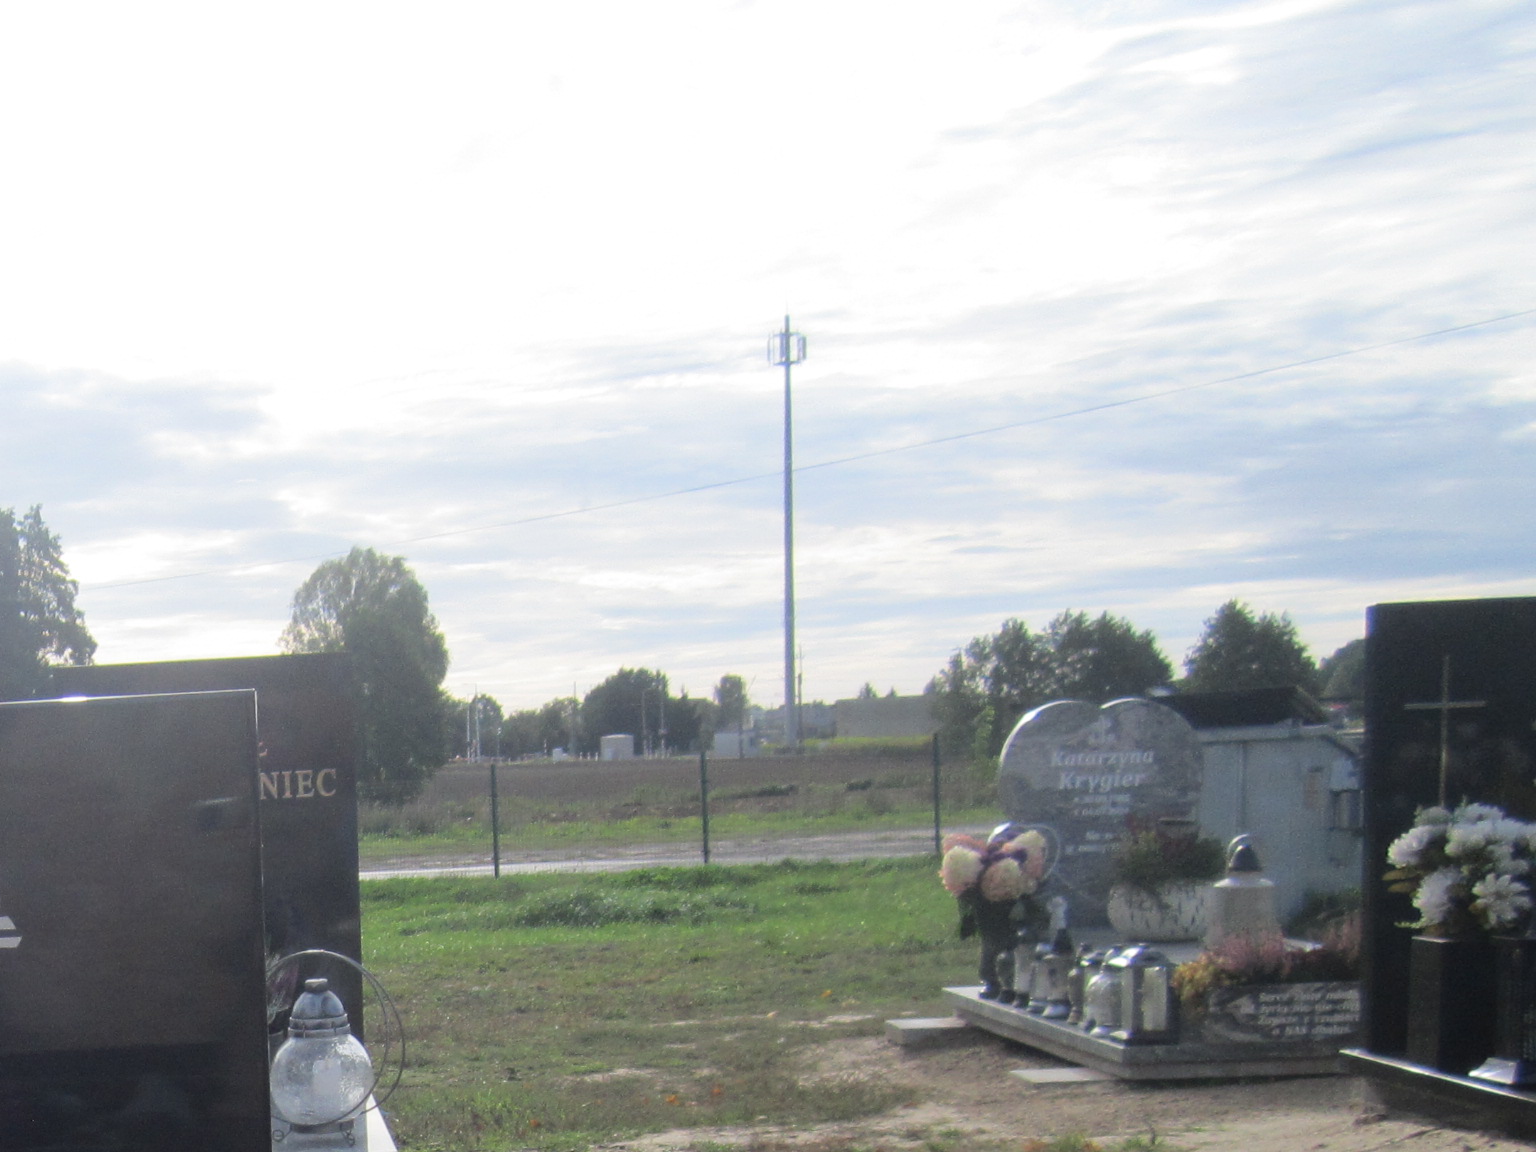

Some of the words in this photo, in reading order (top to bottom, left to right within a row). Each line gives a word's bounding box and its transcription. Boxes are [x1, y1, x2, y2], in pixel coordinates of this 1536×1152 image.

[1051, 750, 1155, 770] Katarzyna
[258, 767, 337, 800] NIEC
[1059, 769, 1147, 793] Krygier
